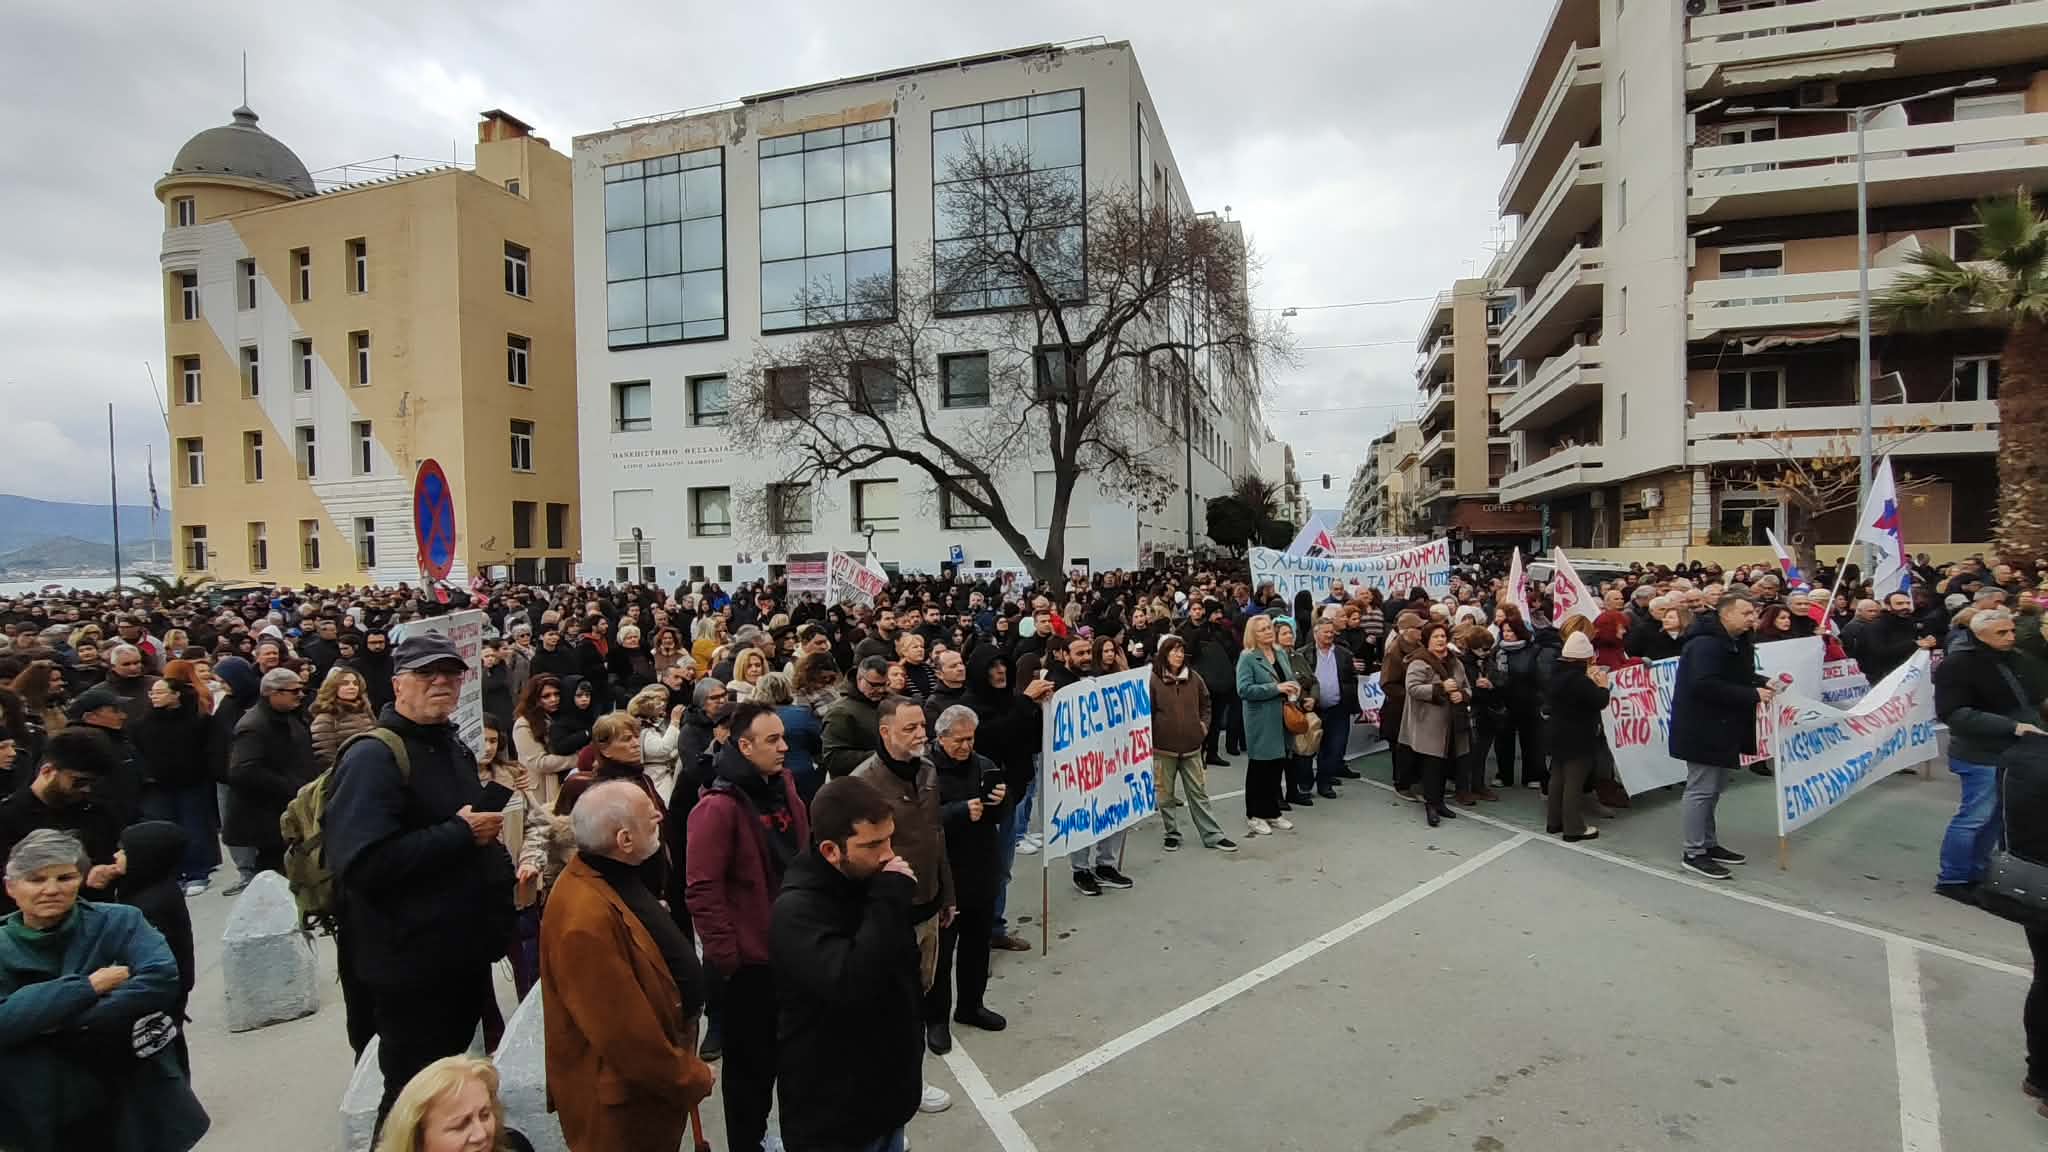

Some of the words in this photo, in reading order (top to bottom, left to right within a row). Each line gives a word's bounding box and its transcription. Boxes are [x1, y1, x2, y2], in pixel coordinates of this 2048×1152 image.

[1482, 504, 1513, 512] COFFEE
[1254, 548, 1267, 571] 3
[1053, 698, 1075, 752] ΔΕΝ
[1060, 762, 1077, 791] ΤΑ
